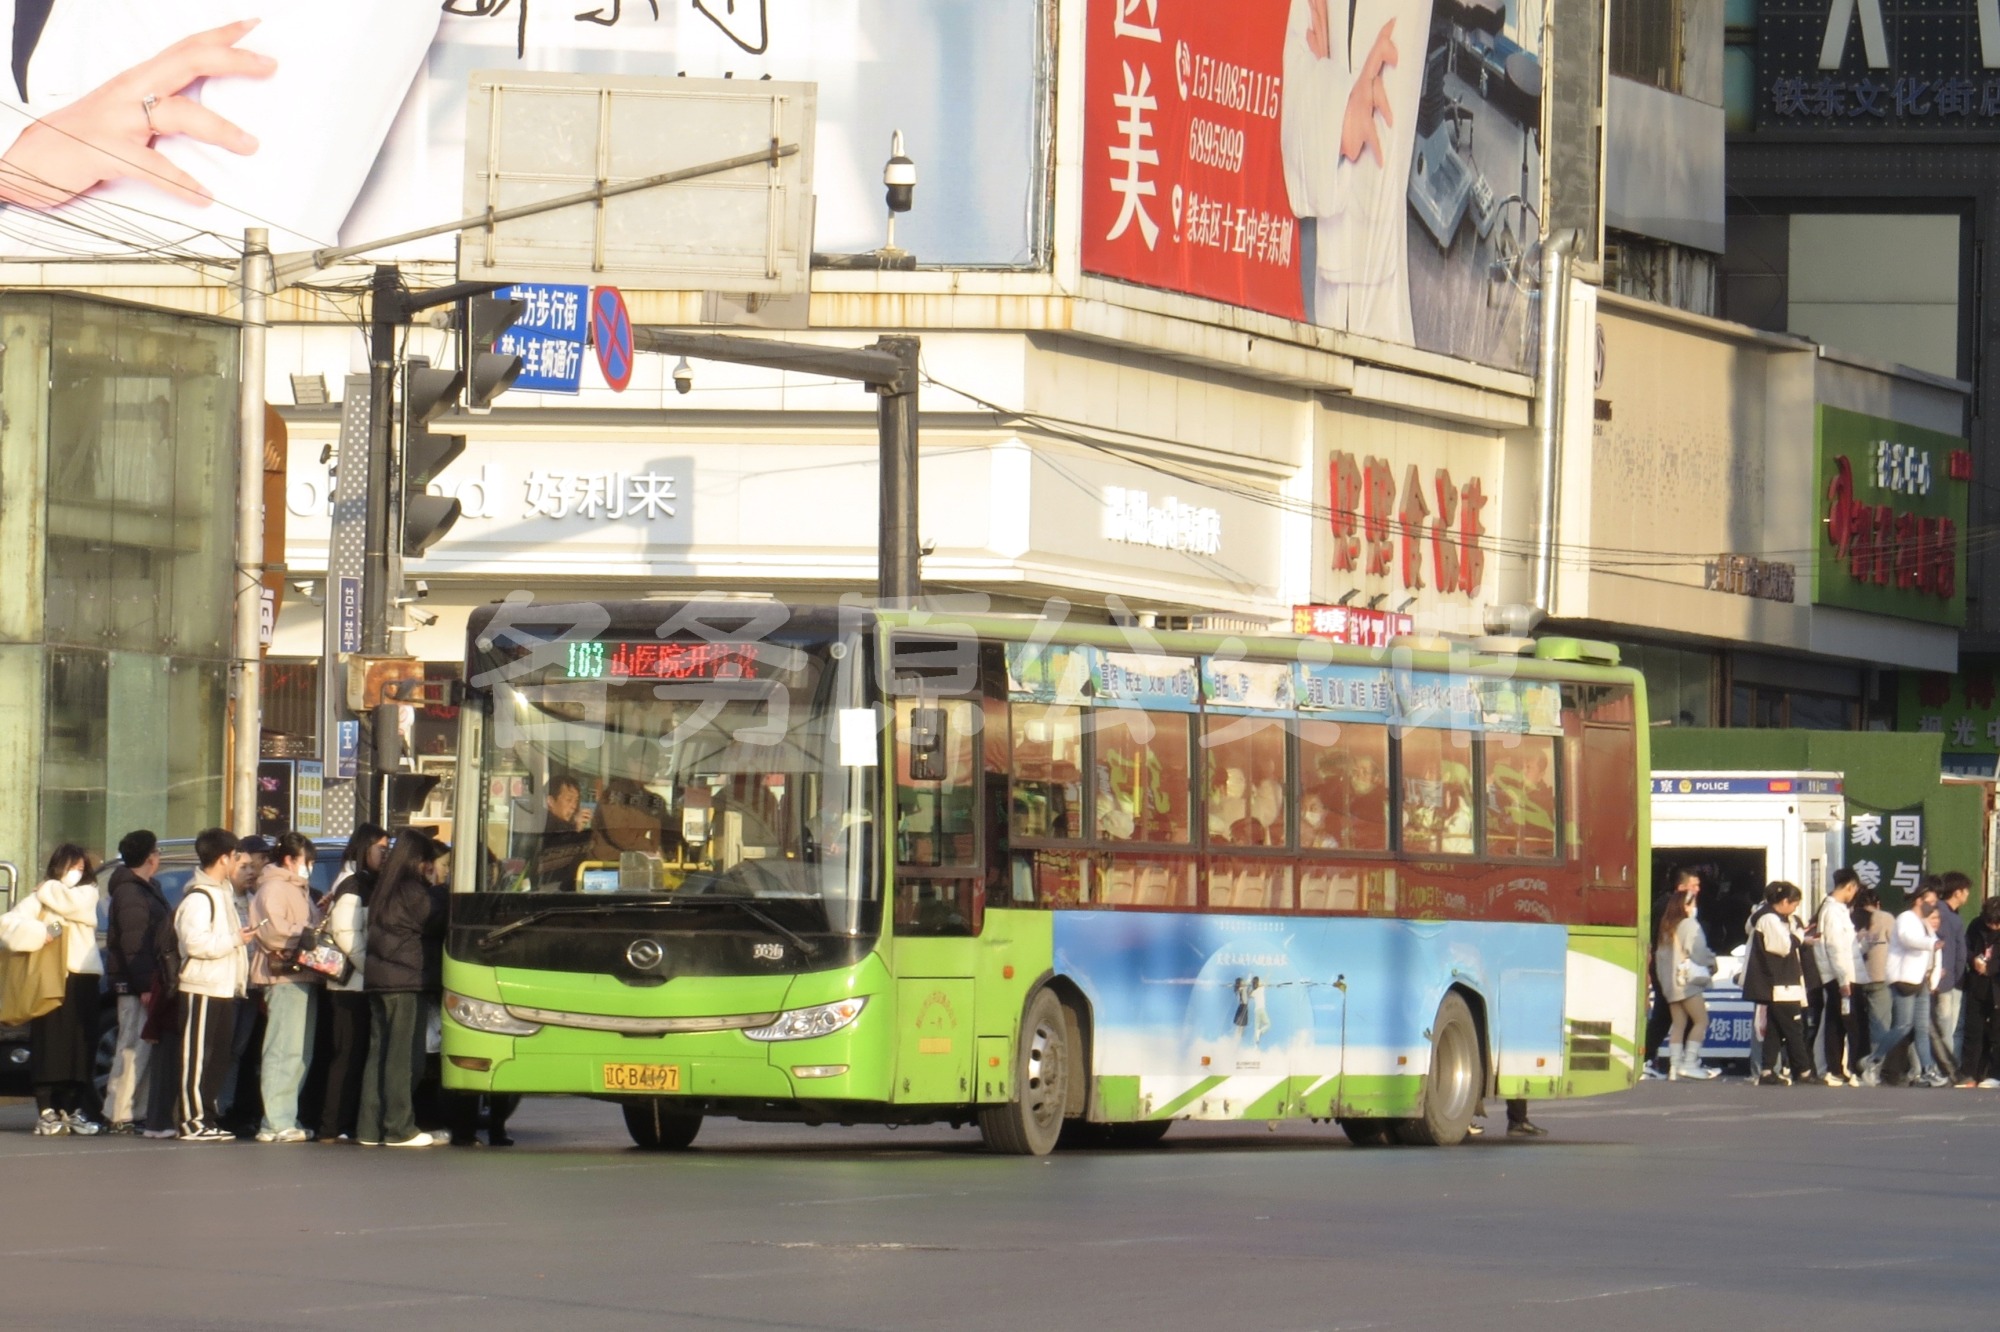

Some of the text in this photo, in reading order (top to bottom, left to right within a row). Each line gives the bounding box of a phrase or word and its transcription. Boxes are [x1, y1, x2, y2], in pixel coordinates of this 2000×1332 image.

[1192, 54, 1281, 119] 15140851115
[1189, 117, 1244, 173] 6895999
[1186, 191, 1294, 268] 铁东区十五中学东侧
[524, 471, 677, 520] 好利来
[567, 642, 604, 678] 103
[1696, 782, 1729, 791] POLICE
[1851, 813, 1921, 847] 家园
[1853, 859, 1921, 894] 参与
[753, 943, 784, 960] 黄海
